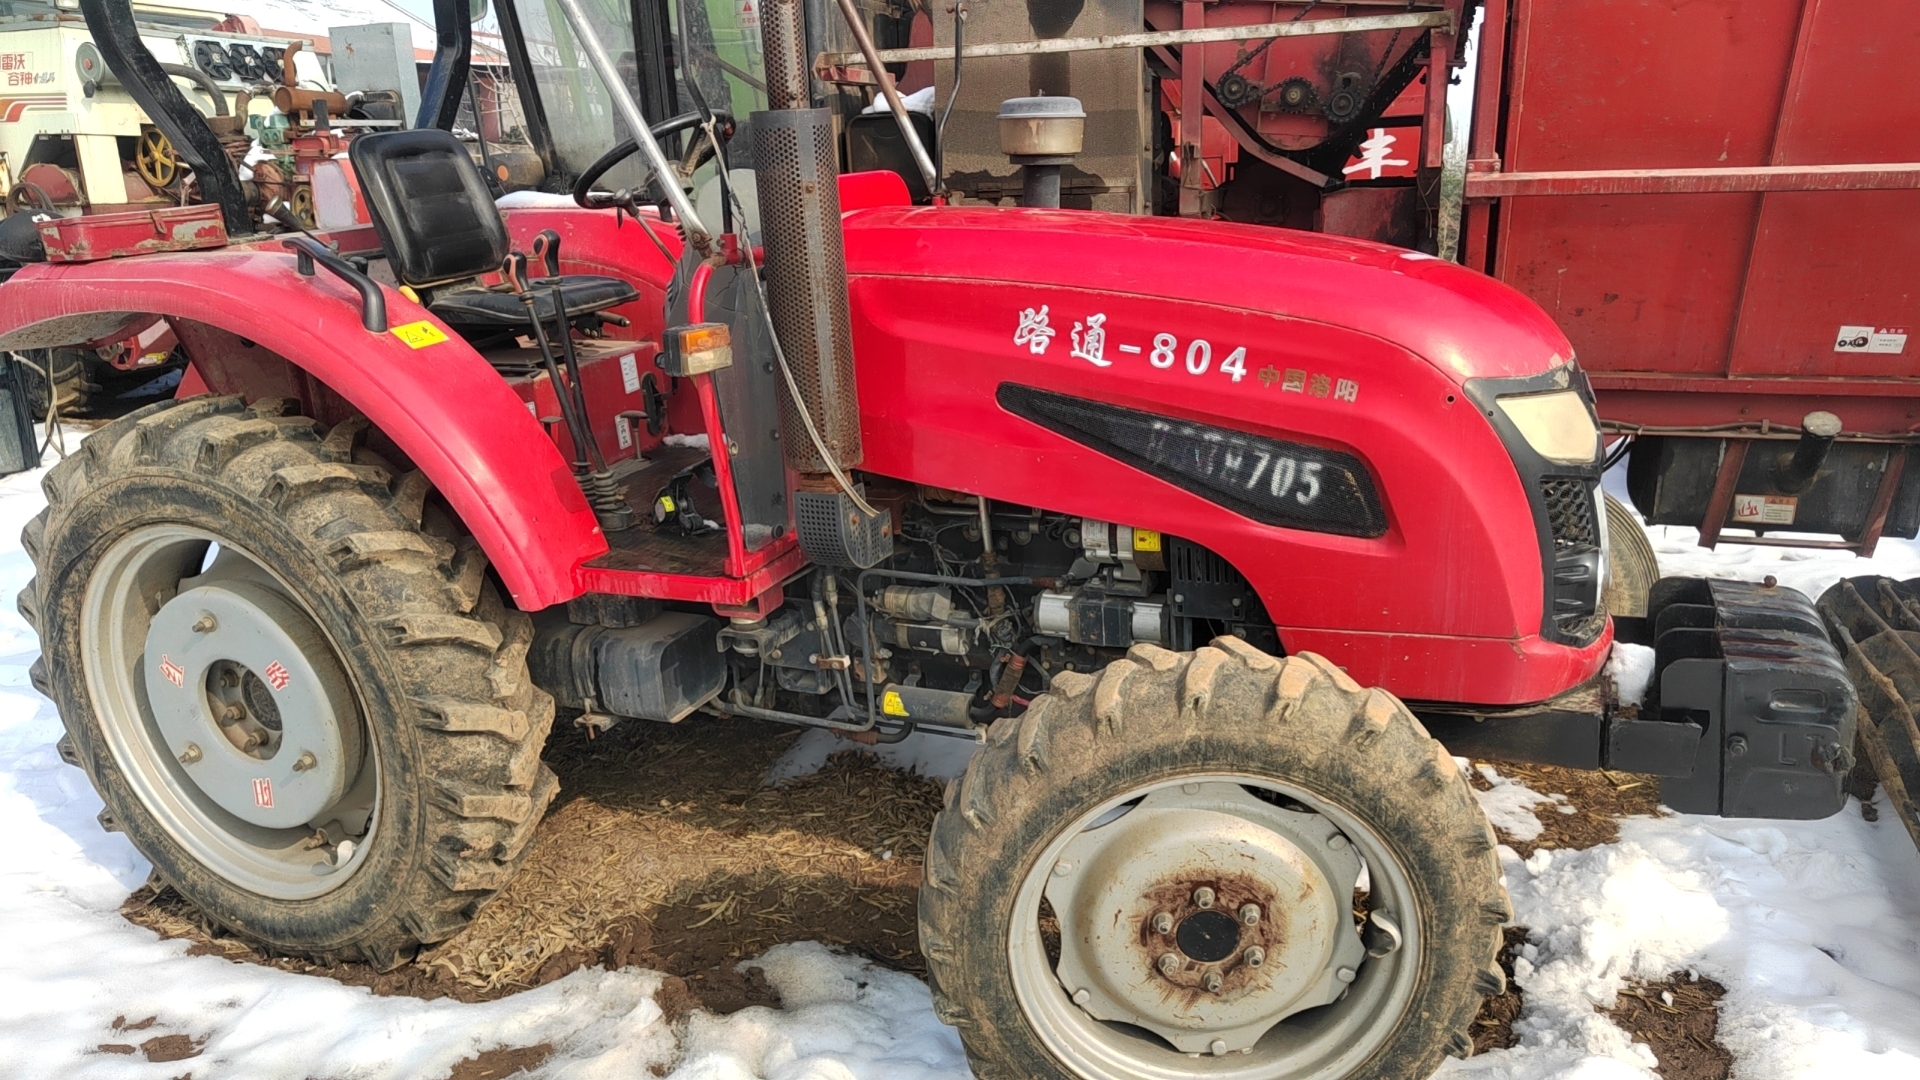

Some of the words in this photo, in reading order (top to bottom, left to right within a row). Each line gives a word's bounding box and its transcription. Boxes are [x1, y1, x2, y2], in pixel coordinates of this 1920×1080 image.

[0, 54, 25, 70] 雷沃
[1258, 364, 1360, 403] 中国洛阳
